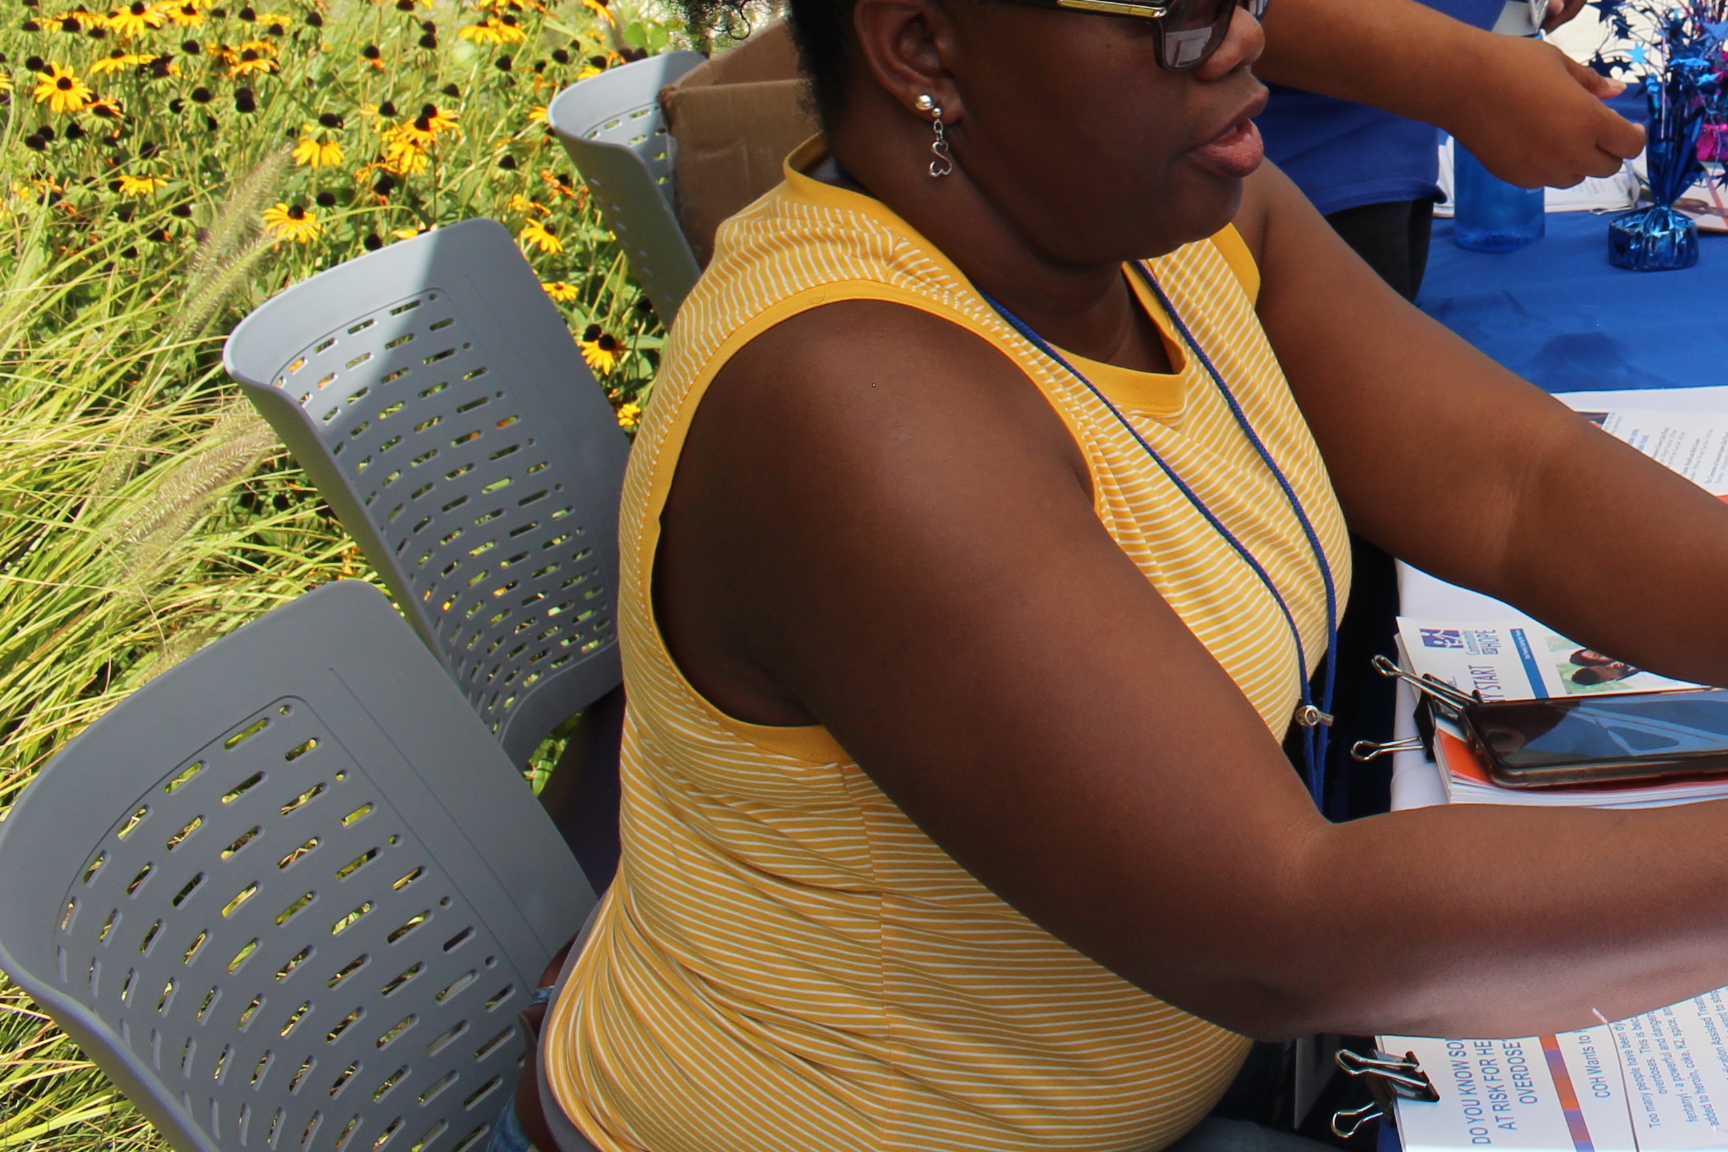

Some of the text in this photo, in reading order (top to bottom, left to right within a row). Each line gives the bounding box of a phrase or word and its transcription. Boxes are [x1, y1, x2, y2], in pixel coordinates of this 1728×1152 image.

[1476, 629, 1501, 647] HOPE
[1468, 632, 1502, 690] START
[1667, 1017, 1682, 1036] spice,
[1700, 1016, 1721, 1044] Assisted
[1637, 1038, 1650, 1054] This
[1653, 1037, 1668, 1050] and
[1479, 1058, 1501, 1081] FOR
[1577, 1035, 1610, 1097] COH Wants to
[1659, 1052, 1684, 1081] powerful
[1680, 1049, 1694, 1068] coke,
[1617, 1032, 1660, 1128] Too many people have been
[1646, 1057, 1667, 1094] overdoses.
[1688, 1069, 1705, 1094] heroin,
[1444, 1038, 1491, 1144] DO YOU KNOW SO
[1486, 1084, 1510, 1111] RISK
[1676, 1093, 1697, 1122] fentanyl
[1700, 1103, 1719, 1125] added
[1494, 1115, 1516, 1130] AT
